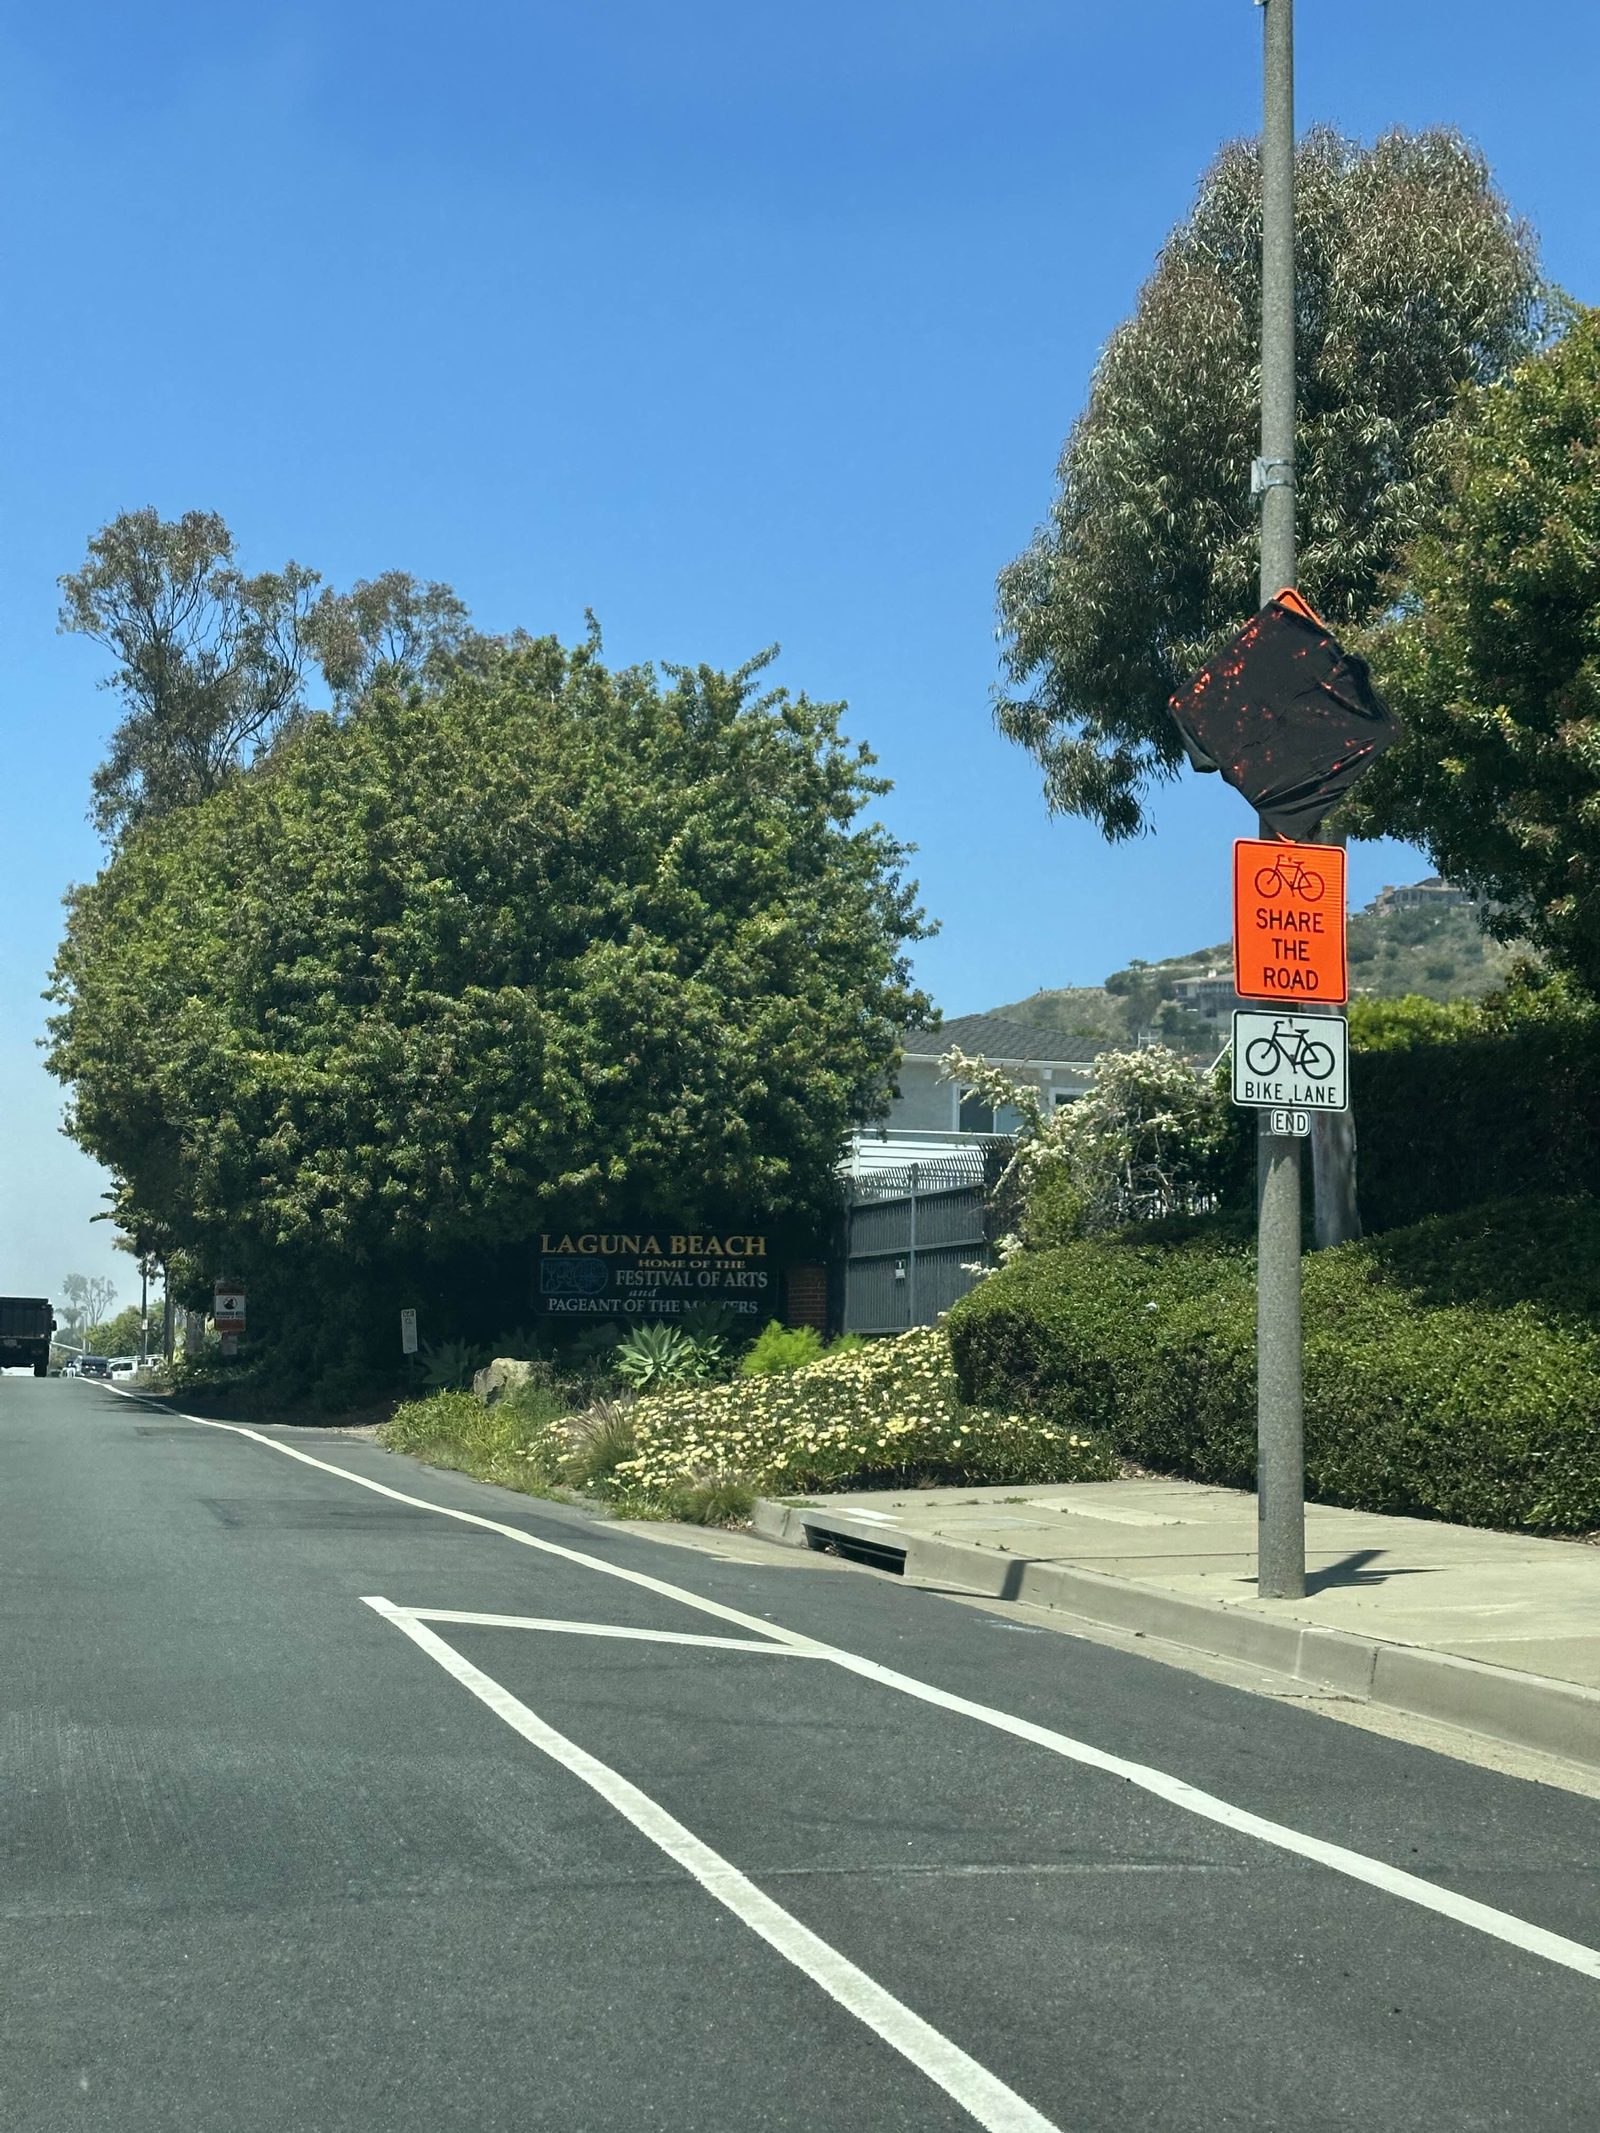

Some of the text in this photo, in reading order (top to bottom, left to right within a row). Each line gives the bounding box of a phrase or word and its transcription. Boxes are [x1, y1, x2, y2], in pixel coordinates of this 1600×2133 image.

[1256, 908, 1325, 933] SHARE
[1271, 938, 1310, 961] THE
[1263, 967, 1319, 990] ROAD
[1245, 1081, 1336, 1104] BIKE LANE
[1276, 1113, 1306, 1131] END
[540, 1234, 768, 1256] LAGUNA BEACH
[638, 1259, 746, 1269] HOME OF THE
[616, 1270, 768, 1288] FESTIVAL OF ARTS
[629, 1288, 657, 1298] and
[548, 1298, 622, 1312] PAGEANT
[624, 1299, 648, 1312] OF
[649, 1299, 680, 1313] THE
